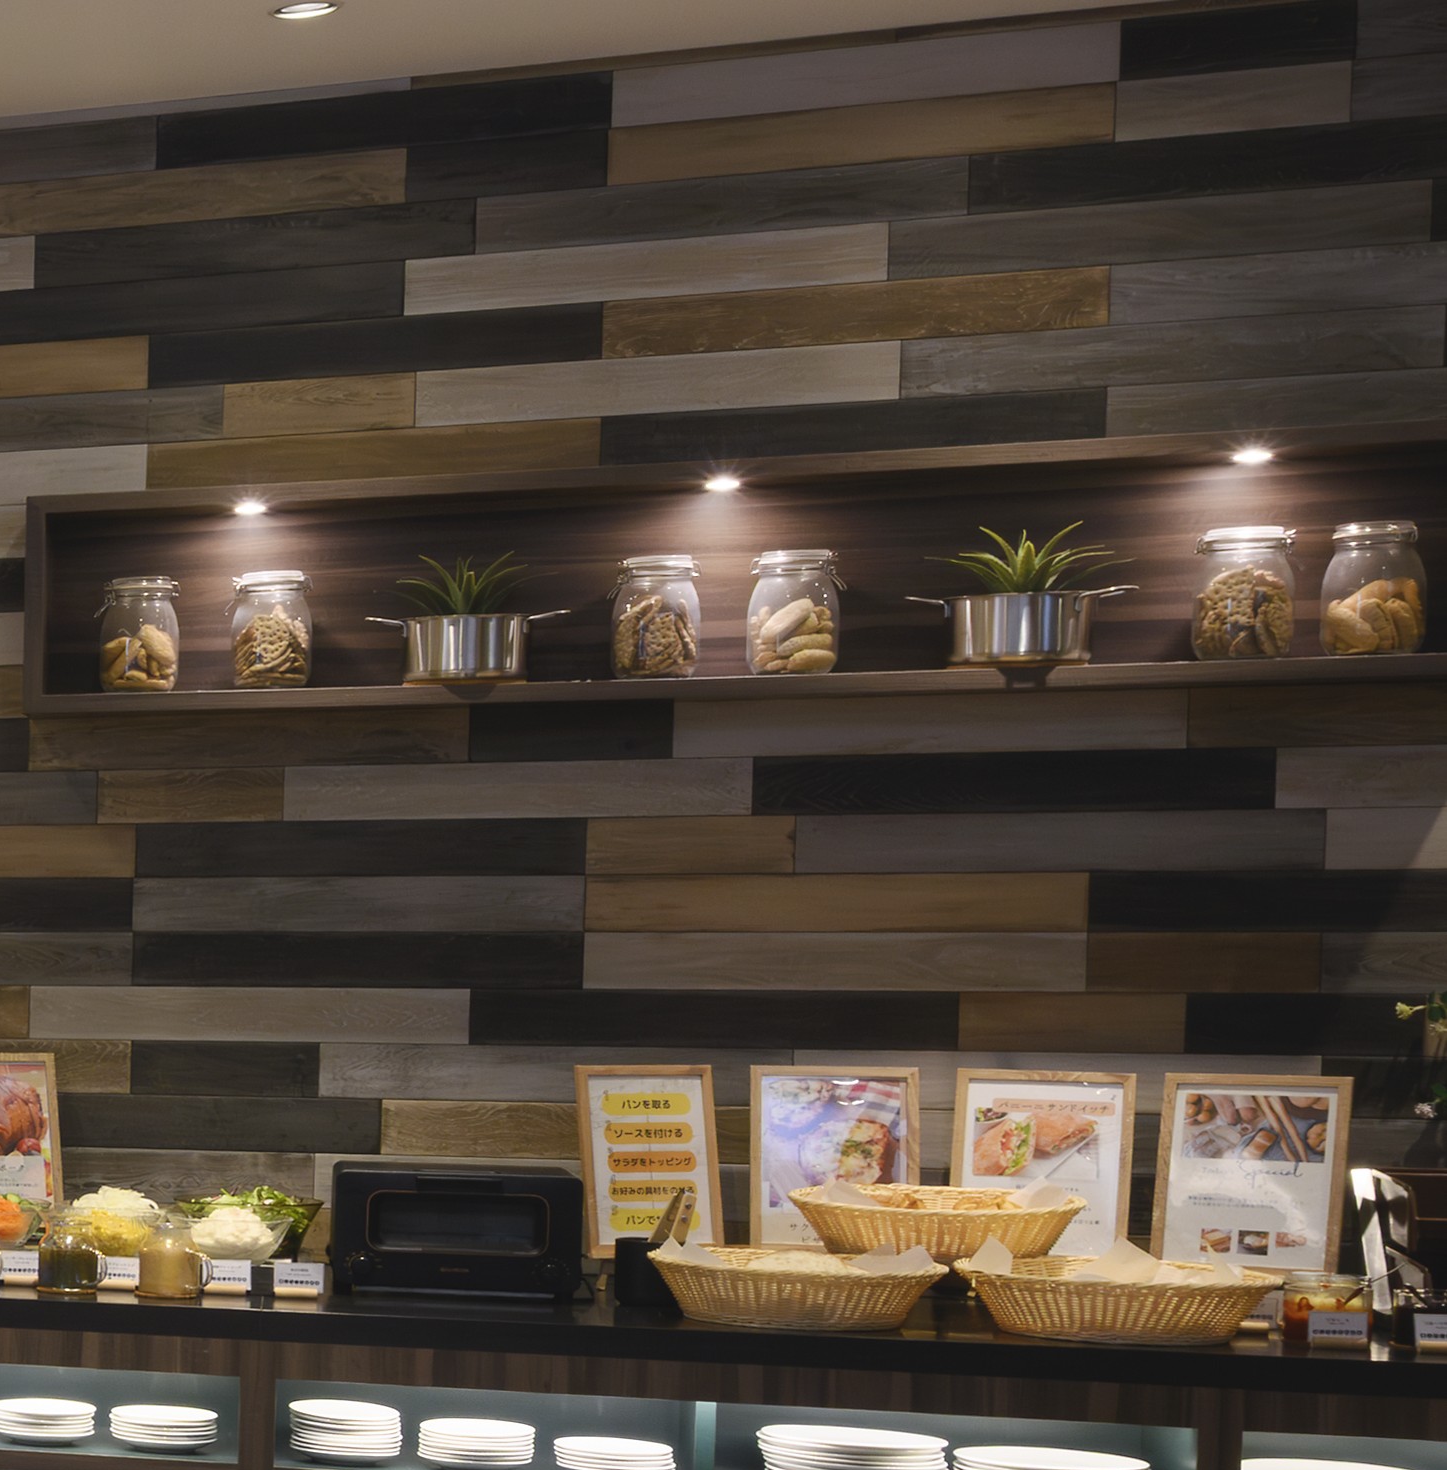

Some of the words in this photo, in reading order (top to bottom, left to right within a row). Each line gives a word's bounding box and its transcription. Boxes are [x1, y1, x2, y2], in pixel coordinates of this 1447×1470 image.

[621, 1099, 671, 1110] パンを取る
[614, 1128, 683, 1139] ソースを付ける
[612, 1157, 692, 1167] サラダをトッピング
[625, 1215, 660, 1226] パンで
